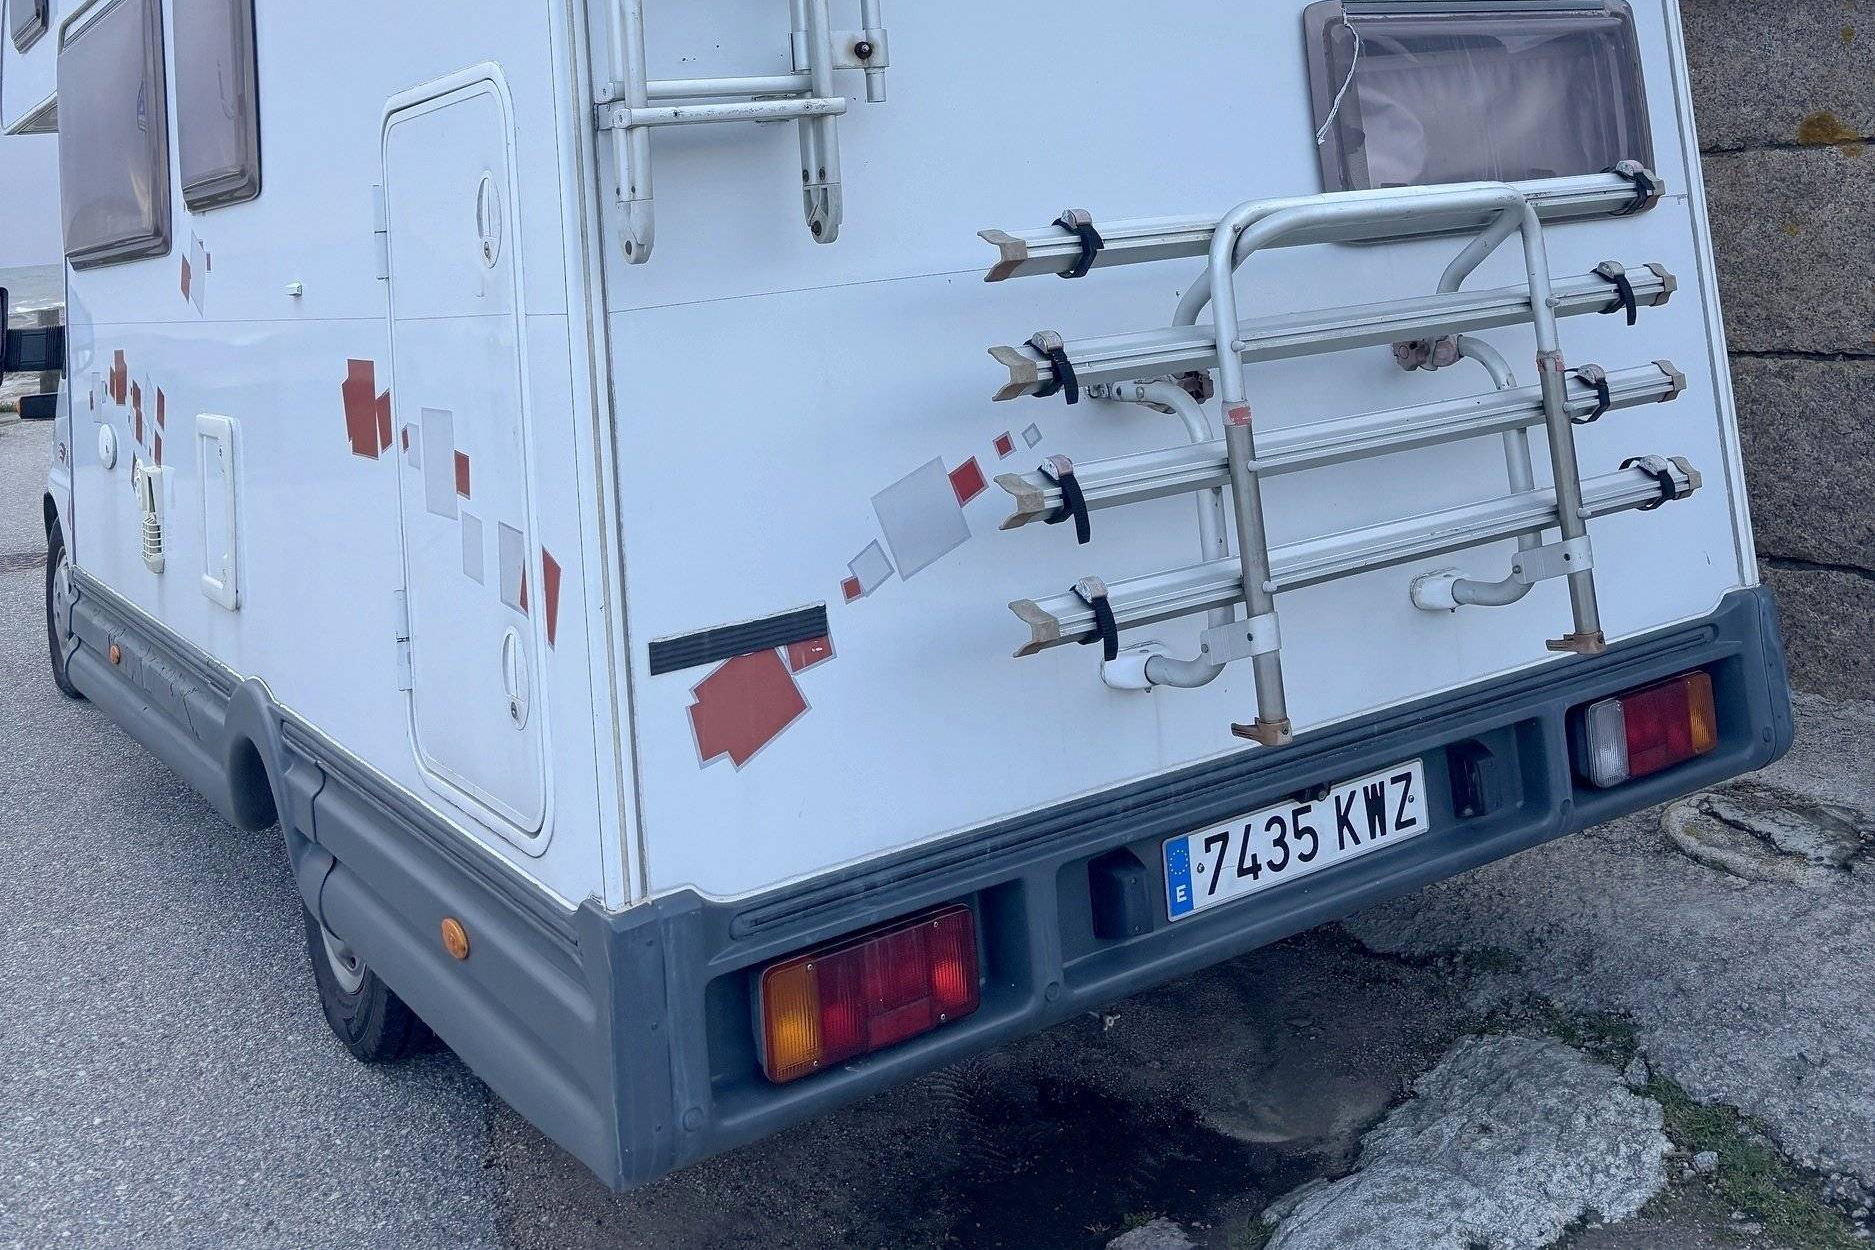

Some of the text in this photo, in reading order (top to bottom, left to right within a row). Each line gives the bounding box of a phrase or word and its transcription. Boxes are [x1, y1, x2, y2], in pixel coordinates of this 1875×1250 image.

[1203, 771, 1417, 896] 7435 KWZ
[1175, 884, 1188, 903] E
